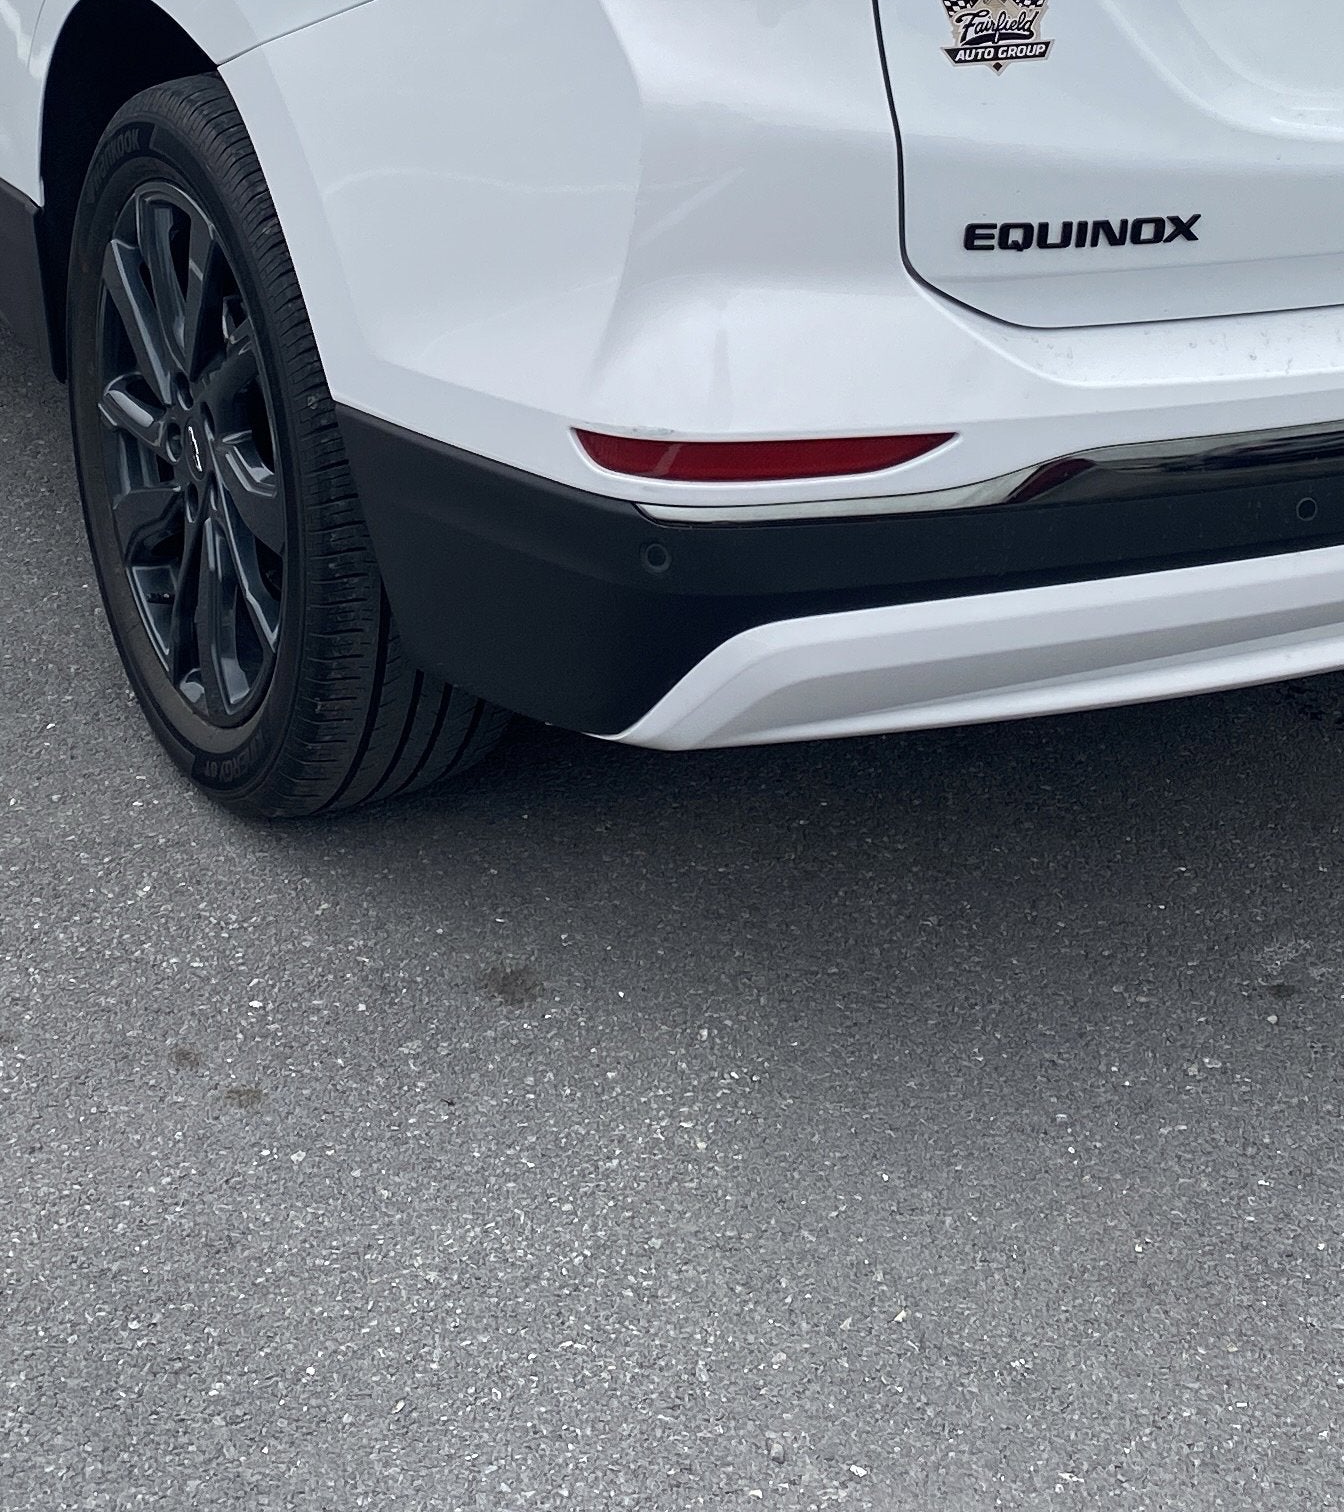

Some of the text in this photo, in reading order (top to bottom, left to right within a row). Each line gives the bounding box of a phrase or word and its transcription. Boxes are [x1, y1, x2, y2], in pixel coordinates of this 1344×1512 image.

[954, 9, 1040, 44] Fairfield
[955, 44, 1046, 62] AUTO GROUP
[963, 213, 1202, 252] EQUINOX
